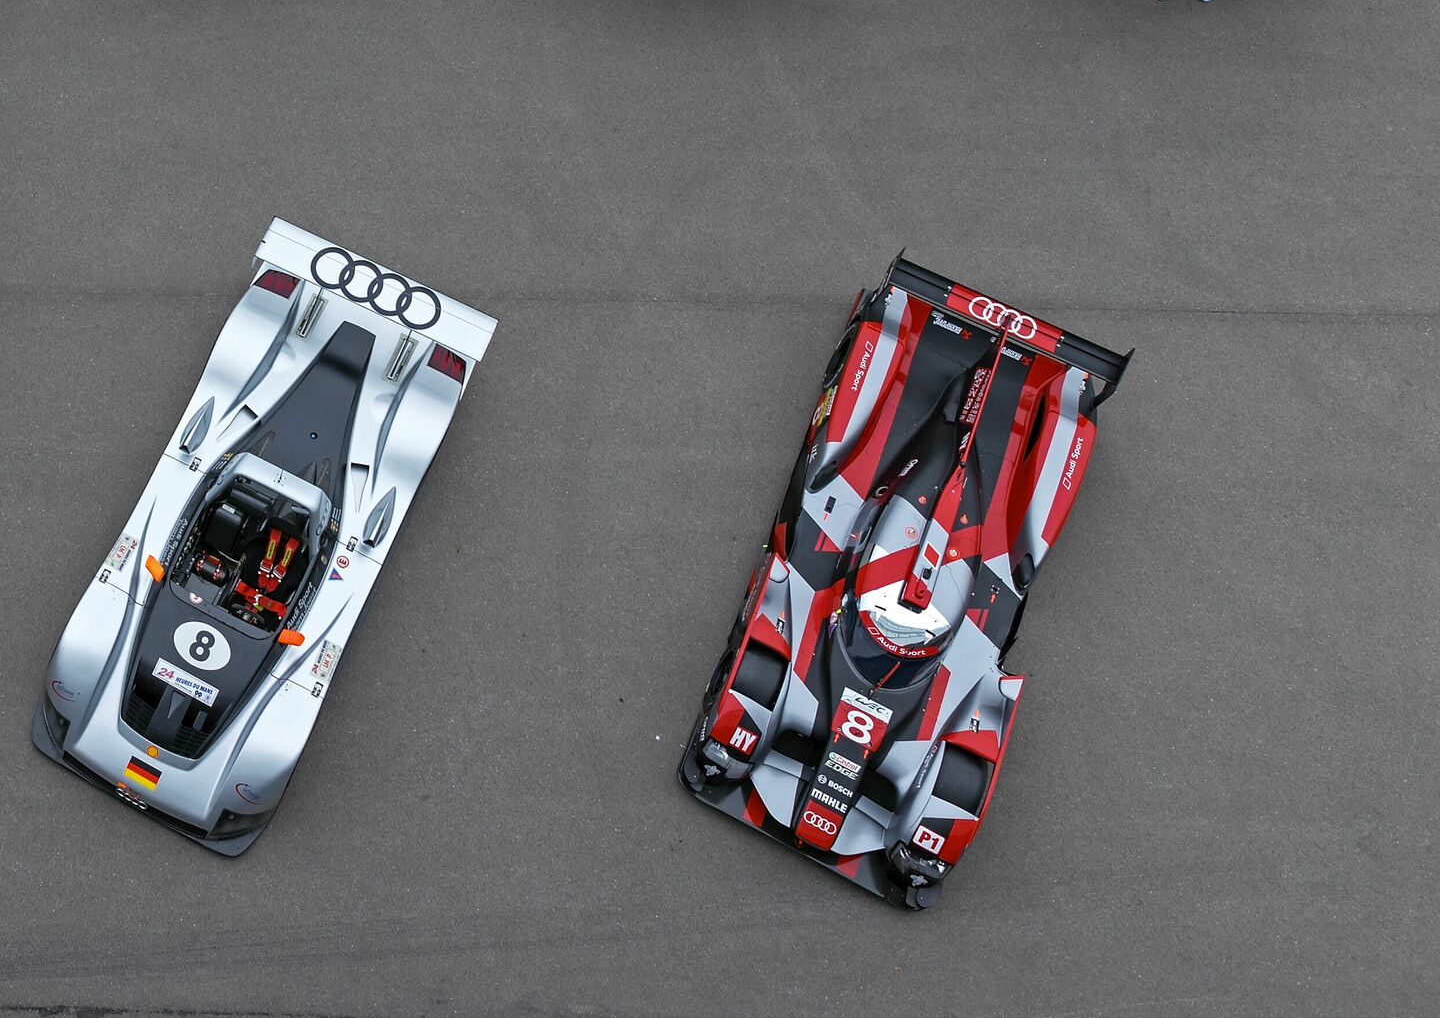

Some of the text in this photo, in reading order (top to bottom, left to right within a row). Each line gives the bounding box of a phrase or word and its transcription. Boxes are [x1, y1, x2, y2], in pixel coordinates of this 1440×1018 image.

[851, 352, 871, 392] Audi Sport
[1066, 437, 1084, 479] Audi Sport
[286, 582, 314, 630] Audi Sport
[189, 630, 216, 662] 8
[877, 636, 898, 652] Audi
[157, 667, 175, 680] 24
[176, 676, 192, 687] HEURES
[192, 680, 200, 689] DU
[200, 685, 214, 695] MANS
[194, 690, 202, 698] 99
[855, 696, 887, 714] WEC
[842, 710, 874, 744] 8
[730, 728, 756, 752] HY
[824, 760, 860, 780] EDGE
[836, 756, 859, 772] Castrol
[811, 788, 848, 814] MAHLE
[828, 780, 854, 798] BOSCH
[918, 830, 940, 850] P1
